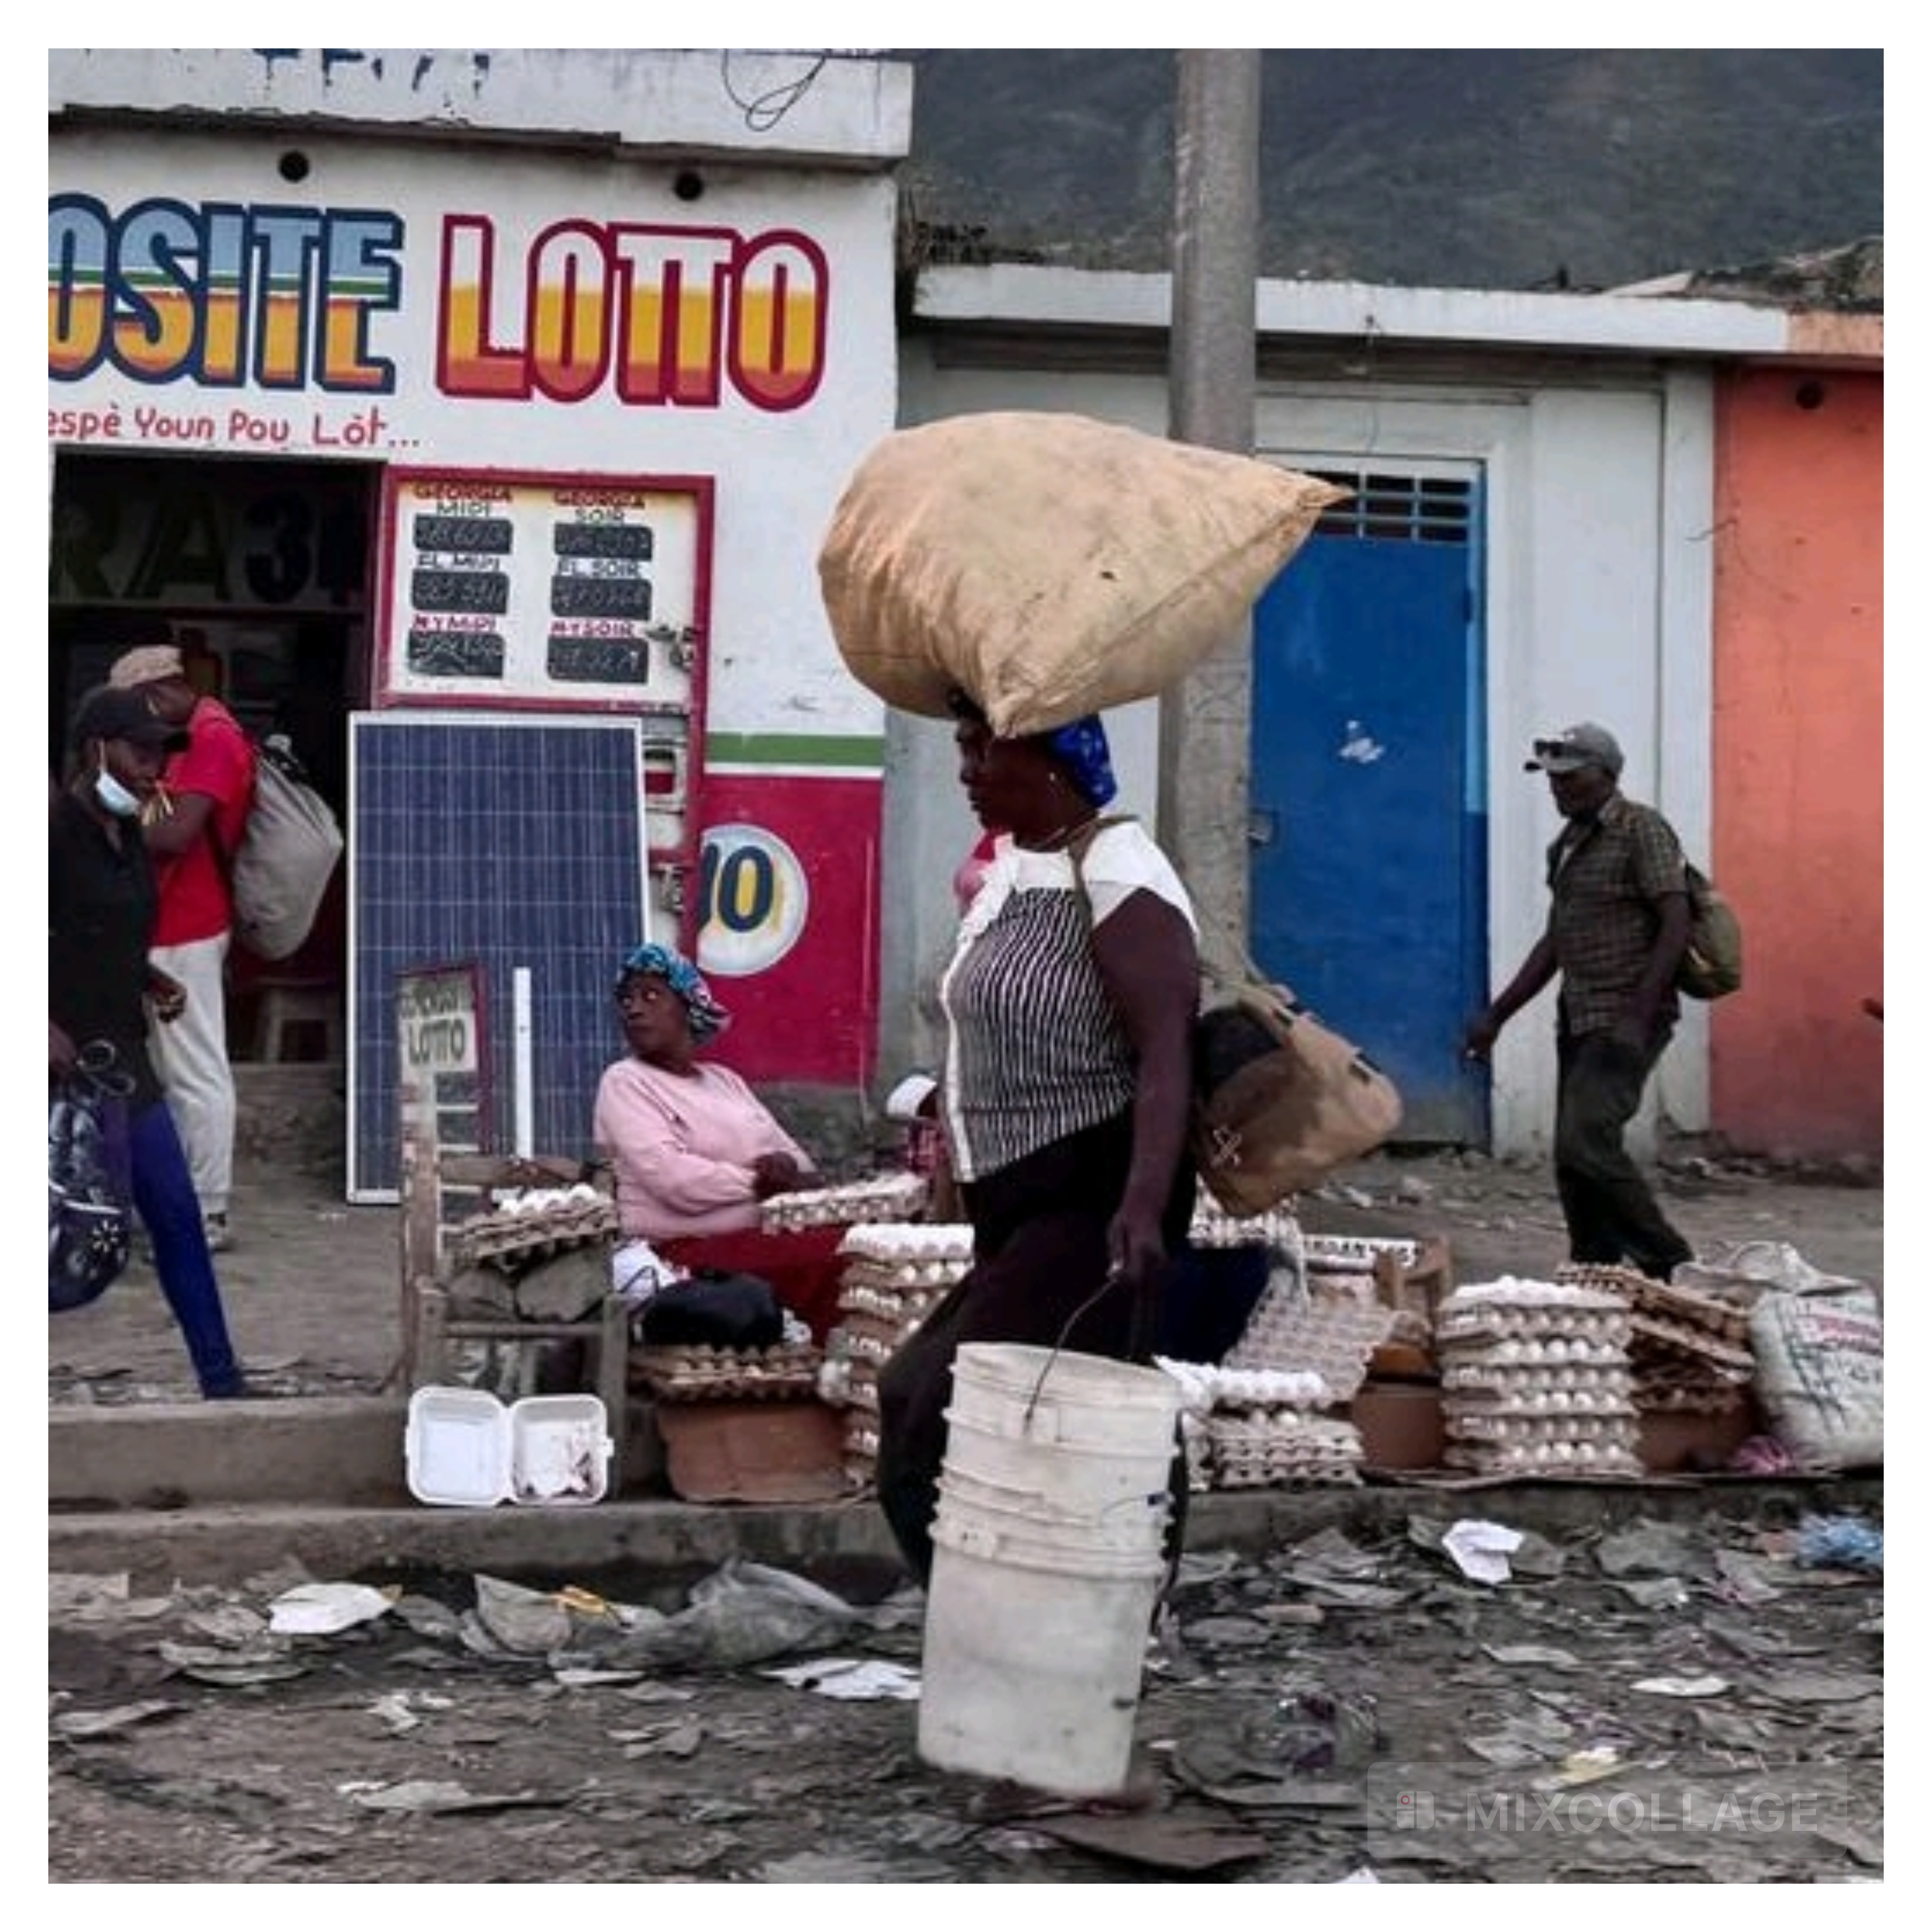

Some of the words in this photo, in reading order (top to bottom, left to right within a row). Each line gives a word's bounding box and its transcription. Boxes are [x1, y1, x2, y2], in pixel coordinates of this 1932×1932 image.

[48, 192, 405, 394] OSITE
[436, 214, 829, 413] LOTTO
[135, 407, 215, 440] Youn
[228, 410, 289, 442] Pou
[408, 1018, 466, 1066] LOTTO
